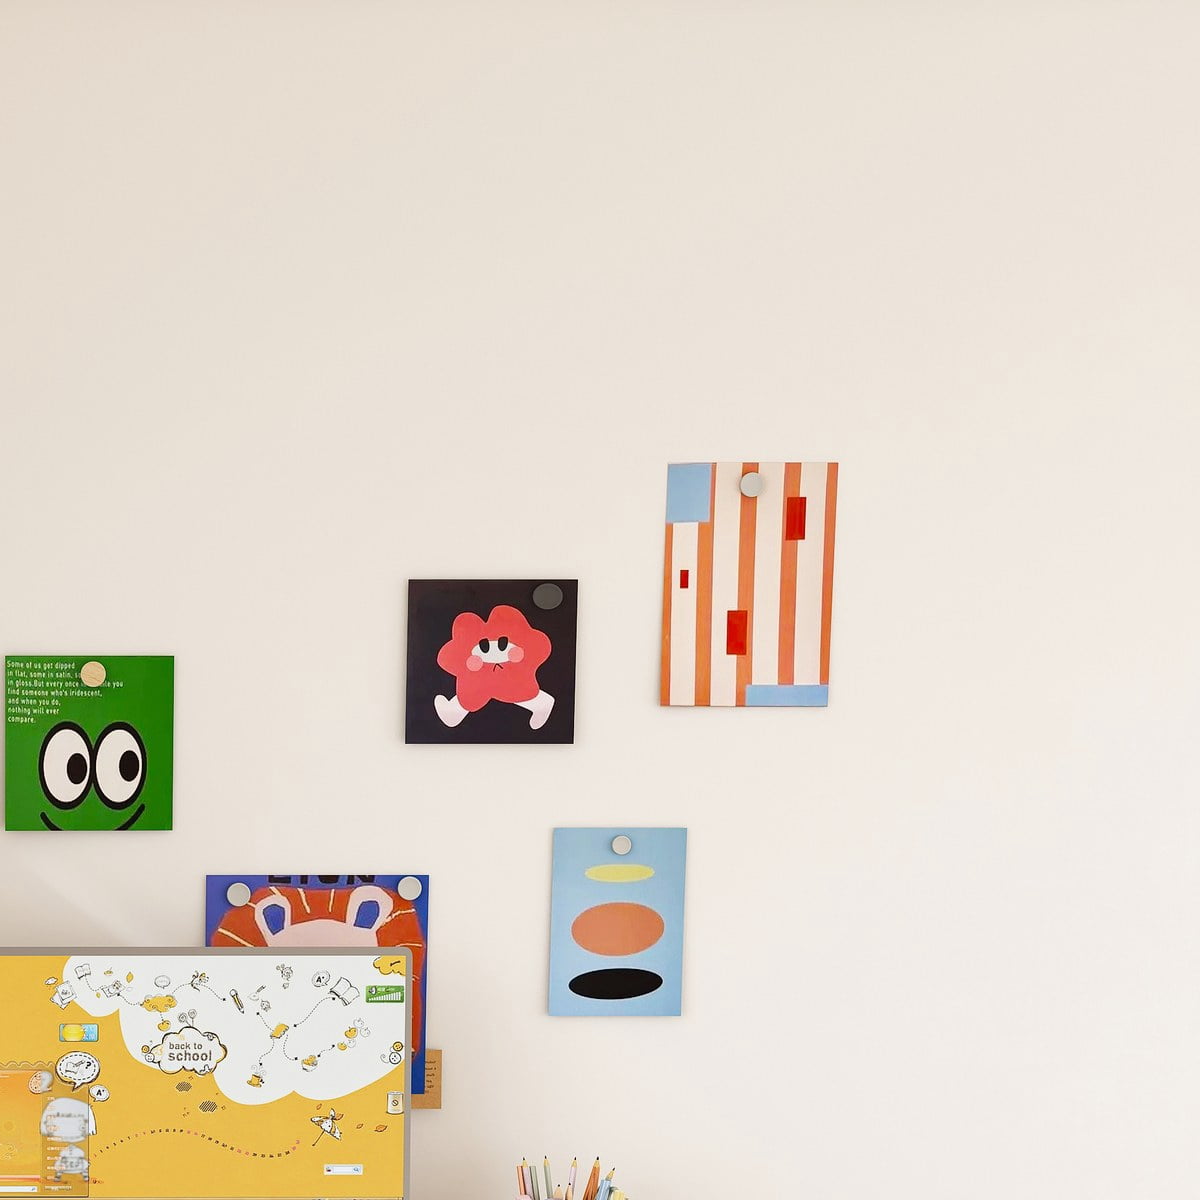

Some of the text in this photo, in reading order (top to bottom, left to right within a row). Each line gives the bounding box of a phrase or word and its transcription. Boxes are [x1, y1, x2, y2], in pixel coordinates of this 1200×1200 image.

[26, 661, 32, 669] of
[43, 662, 53, 670] get
[55, 662, 75, 670] dipped
[46, 681, 63, 689] every
[113, 681, 124, 689] you
[8, 688, 19, 696] find
[8, 707, 31, 715] nothing
[169, 1042, 203, 1050] back to
[168, 1050, 212, 1061] school
